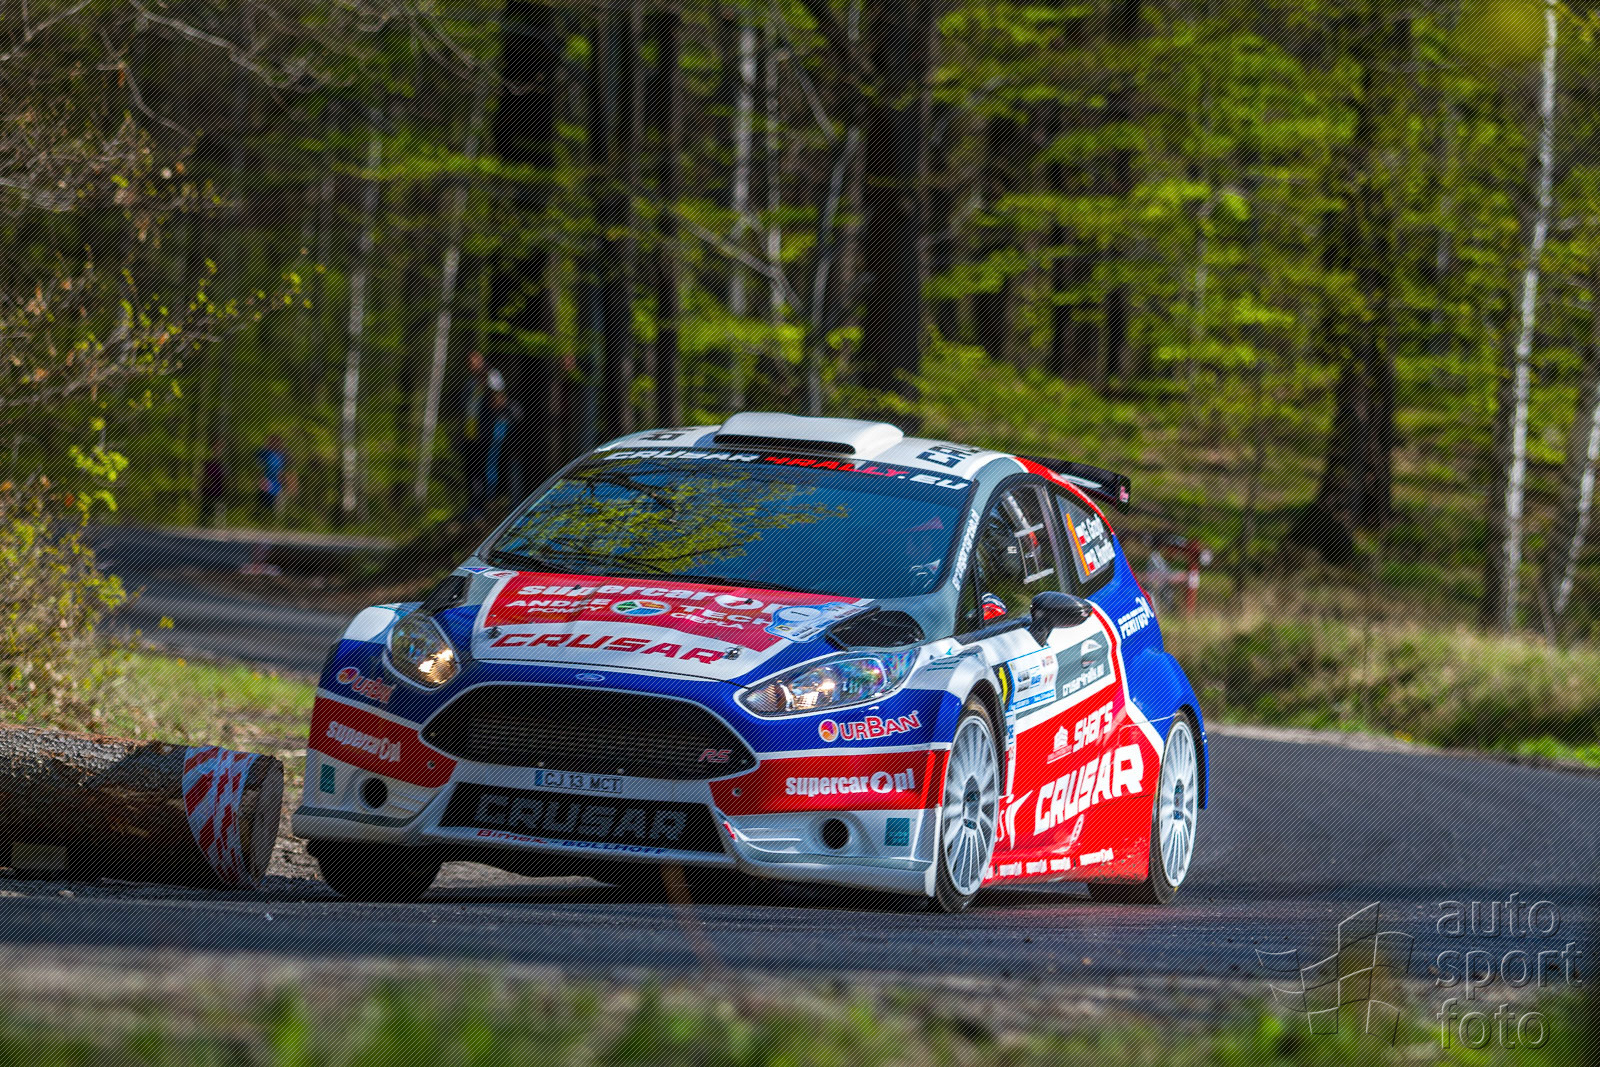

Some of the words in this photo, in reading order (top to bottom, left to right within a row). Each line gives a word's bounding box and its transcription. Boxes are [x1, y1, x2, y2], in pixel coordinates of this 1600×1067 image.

[490, 633, 724, 664] CRUSAR
[839, 711, 922, 741] URBAN
[698, 748, 731, 763] RS
[544, 772, 565, 786] CJ
[568, 774, 584, 788] 13
[590, 777, 621, 791] MCT
[1033, 743, 1145, 836] CRUSAR
[473, 793, 689, 841] CRUSAR
